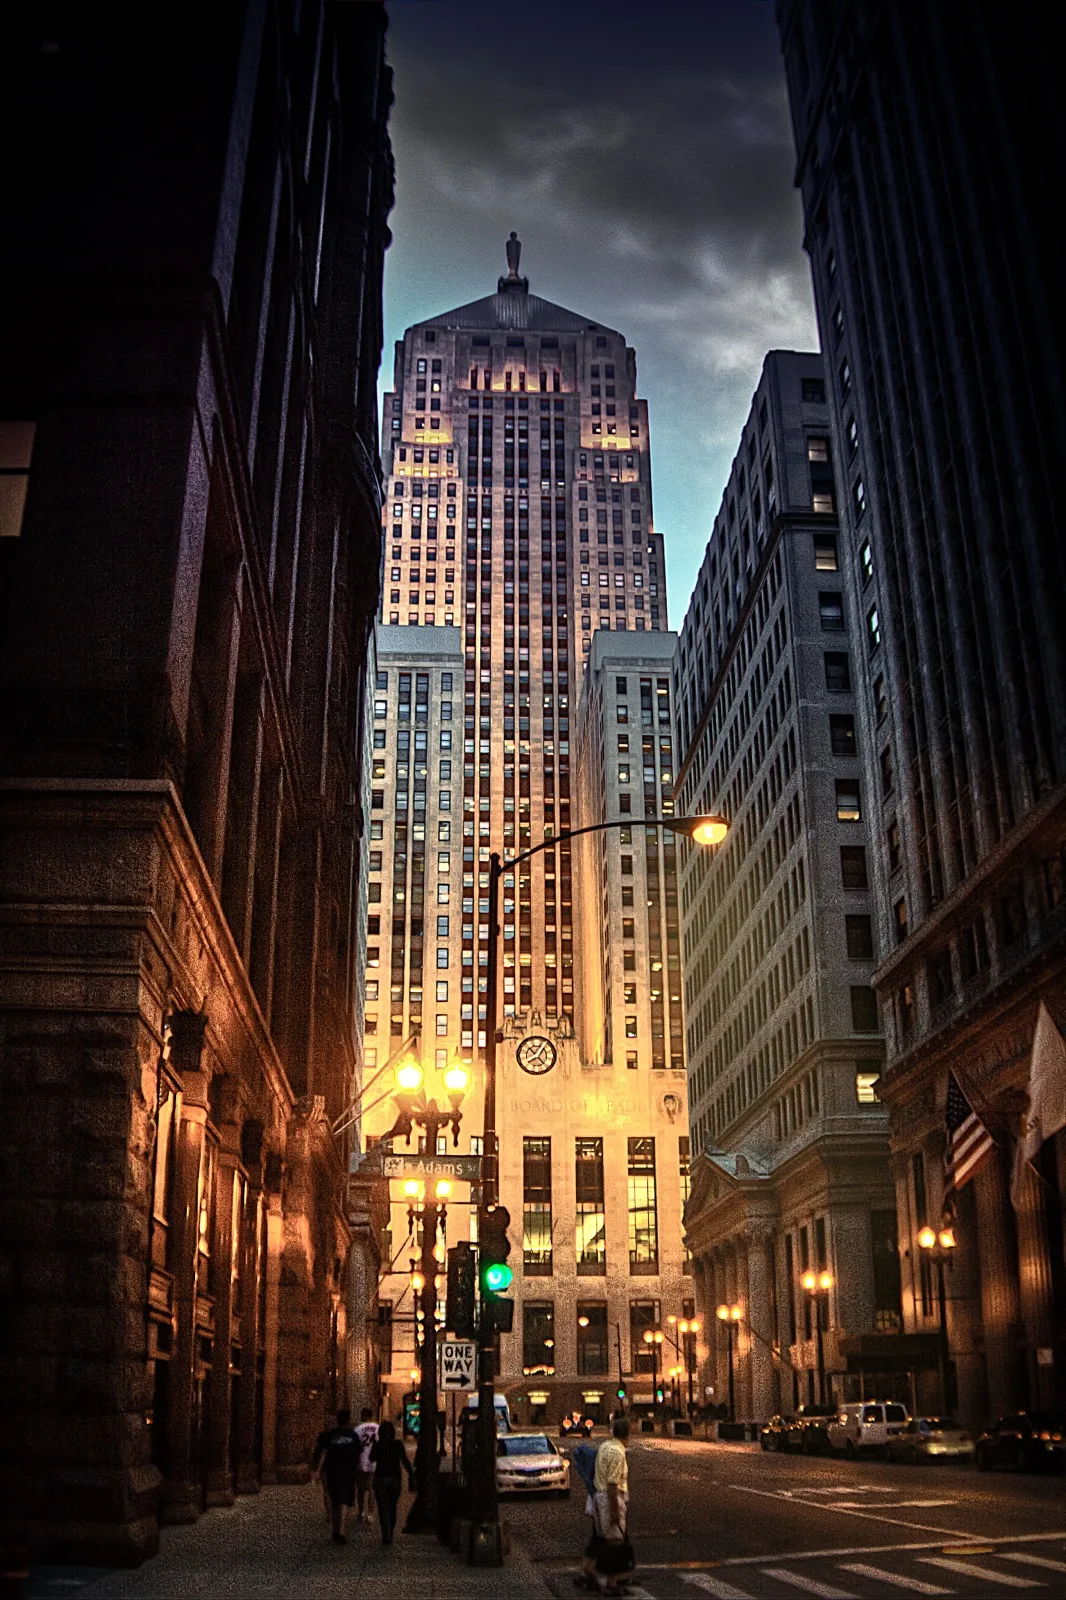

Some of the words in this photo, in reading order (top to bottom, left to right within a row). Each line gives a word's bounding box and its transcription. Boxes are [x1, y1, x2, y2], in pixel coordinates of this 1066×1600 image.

[417, 1160, 463, 1175] Adams
[445, 1346, 472, 1358] ONE
[444, 1360, 473, 1372] WAY
